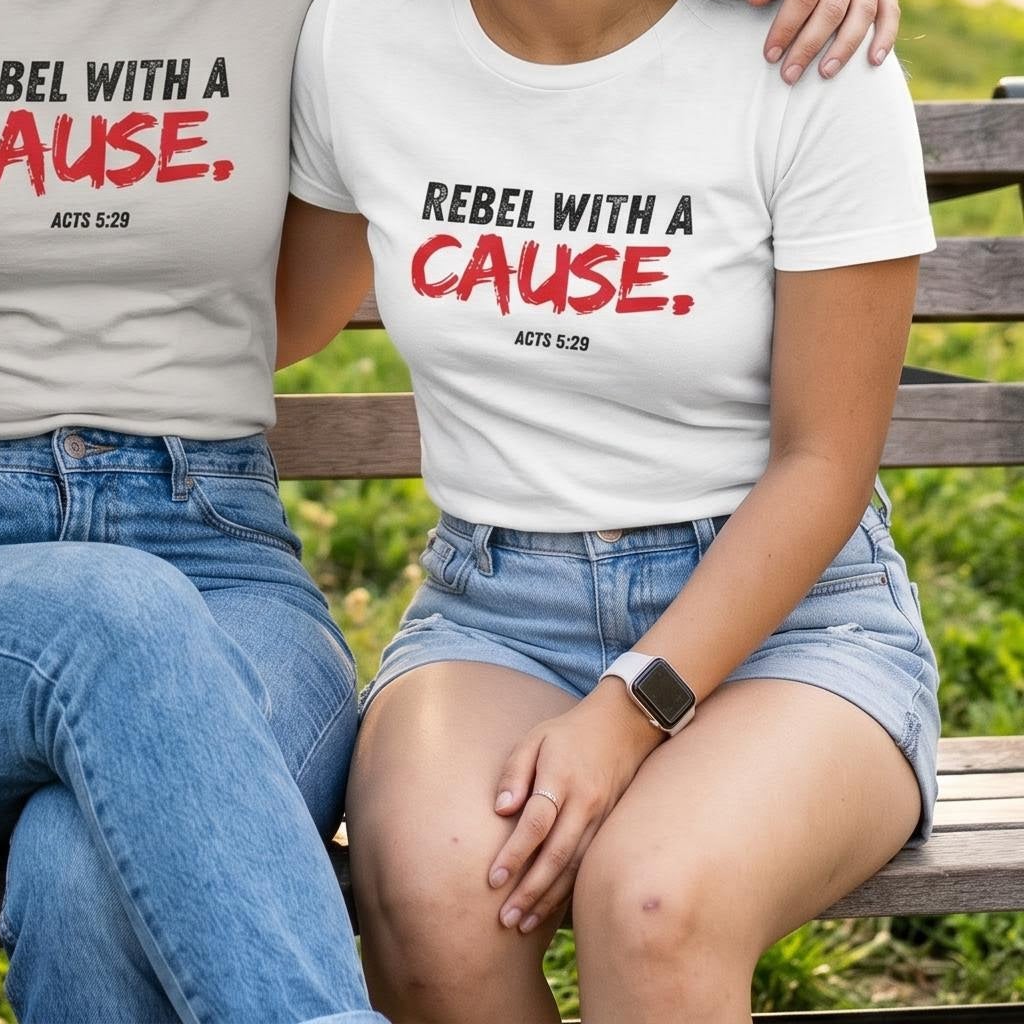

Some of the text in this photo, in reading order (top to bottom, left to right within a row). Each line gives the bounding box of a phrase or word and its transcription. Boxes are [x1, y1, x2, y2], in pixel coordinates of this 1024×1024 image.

[86, 58, 191, 102] WITH
[203, 56, 230, 99] A
[50, 211, 130, 229] ACTS 5:29
[422, 181, 693, 235] REBEL WITH A
[411, 233, 695, 317] CAUSE.
[514, 330, 590, 352] ACTS 5:29
